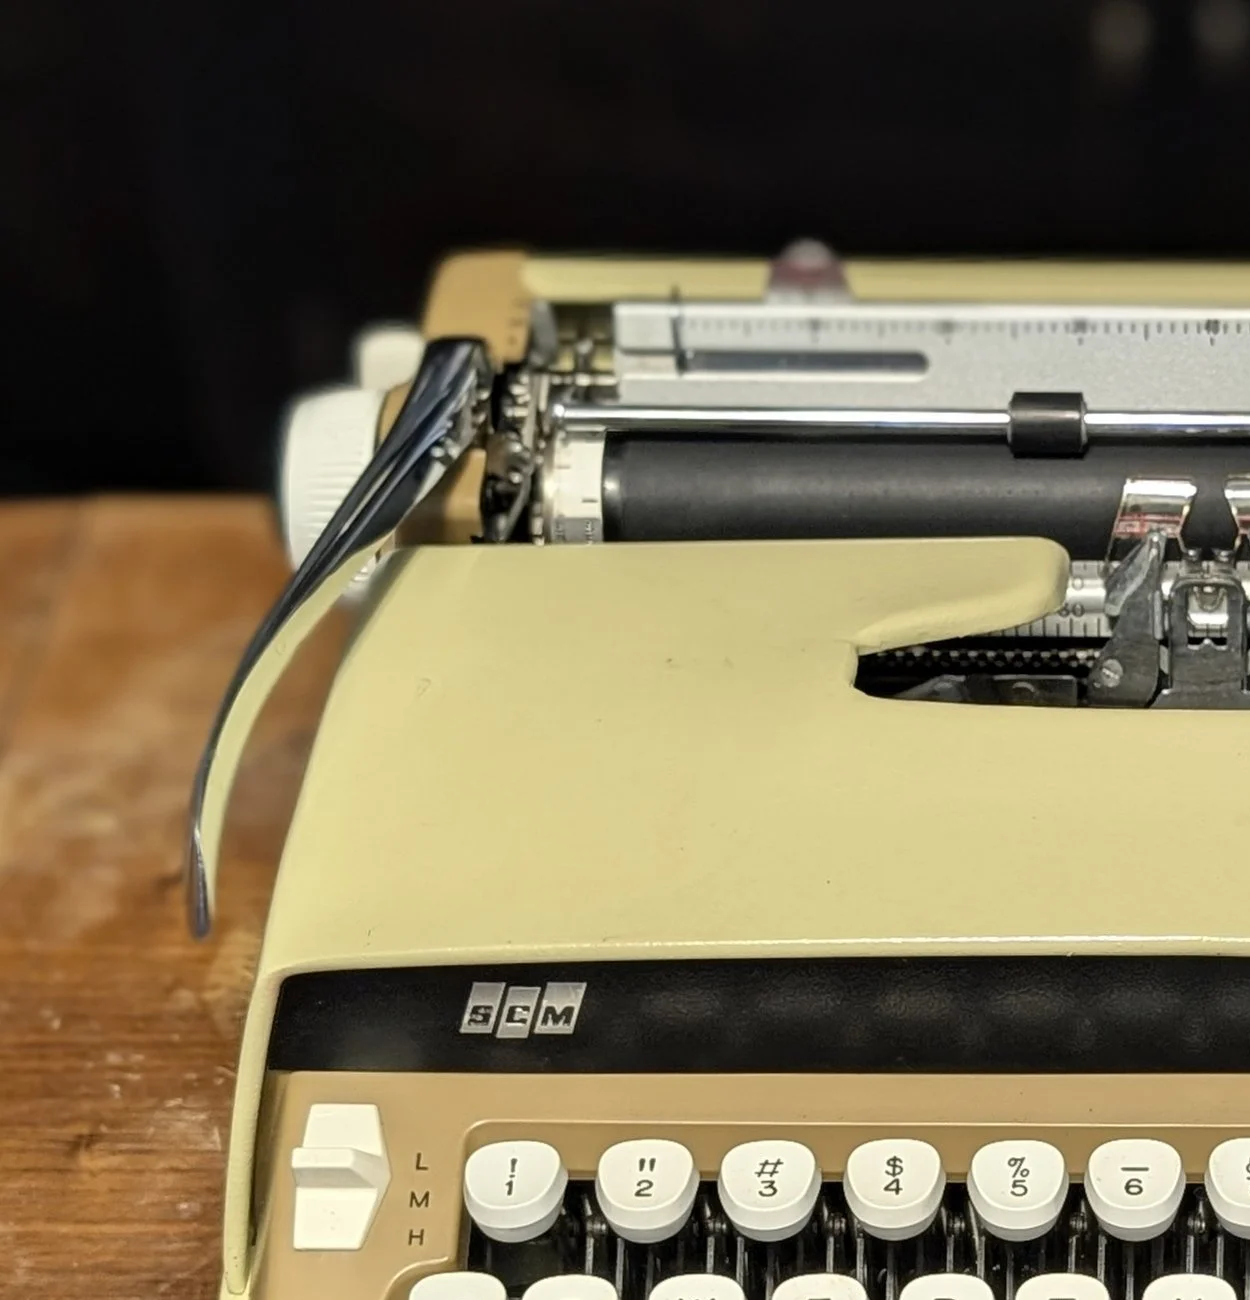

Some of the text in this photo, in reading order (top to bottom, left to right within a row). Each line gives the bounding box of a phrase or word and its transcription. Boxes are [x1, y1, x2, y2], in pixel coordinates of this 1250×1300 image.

[415, 1152, 429, 1171] L
[754, 1158, 784, 1178] #
[884, 1155, 904, 1178] $
[1007, 1156, 1030, 1179] %
[505, 1179, 514, 1197] 1
[634, 1179, 654, 1198] 2
[758, 1179, 778, 1198] 3
[883, 1177, 903, 1196] 4
[1010, 1179, 1029, 1197] 5
[1123, 1178, 1144, 1196] 6
[409, 1190, 430, 1208] M
[407, 1228, 425, 1246] H
